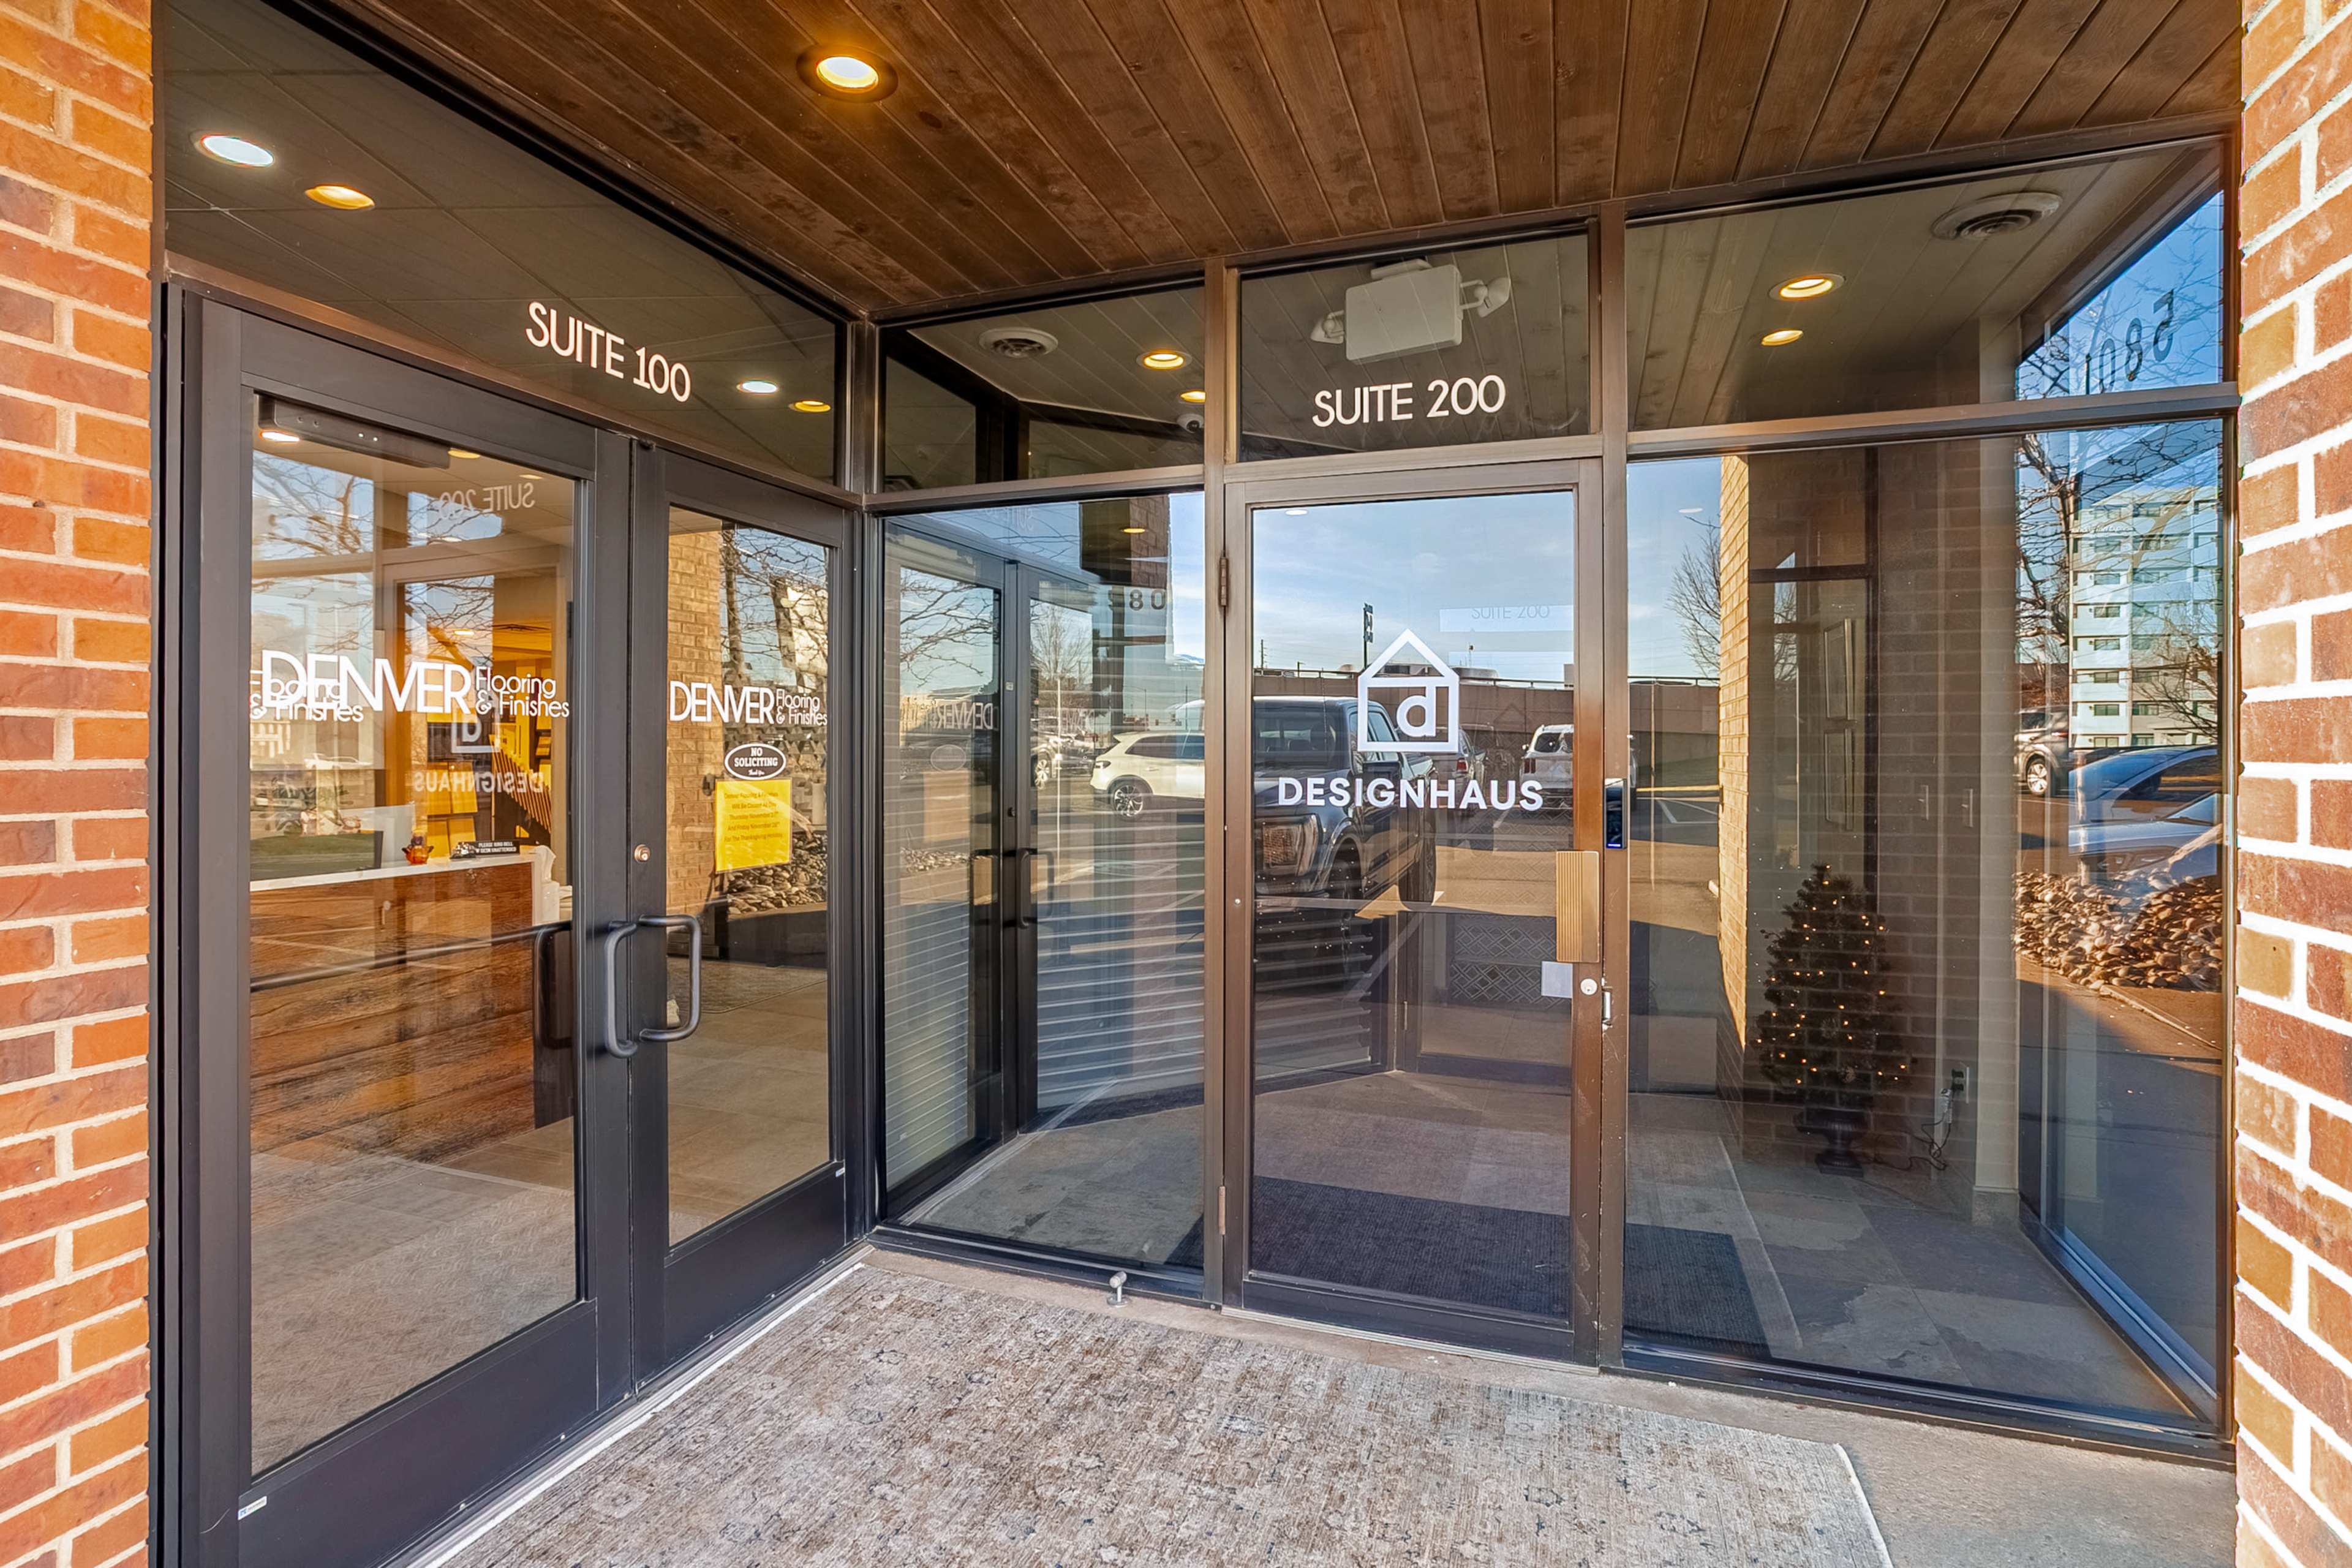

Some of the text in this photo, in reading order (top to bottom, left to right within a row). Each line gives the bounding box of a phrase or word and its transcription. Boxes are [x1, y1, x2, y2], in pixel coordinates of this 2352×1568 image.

[526, 301, 691, 402] SUITE 100
[1312, 374, 1506, 428] SUITE 200
[1471, 606, 1512, 619] SUITE
[262, 649, 472, 714] DENVER
[475, 666, 557, 699] Flooring
[475, 689, 570, 718] & Finishes
[669, 680, 774, 724] DENVER
[776, 688, 820, 710] Flooring
[776, 707, 827, 726] & Finishes
[734, 757, 778, 767] SOLICITING
[750, 747, 763, 756] NO
[1278, 777, 1544, 810] DESIGNHAUS
